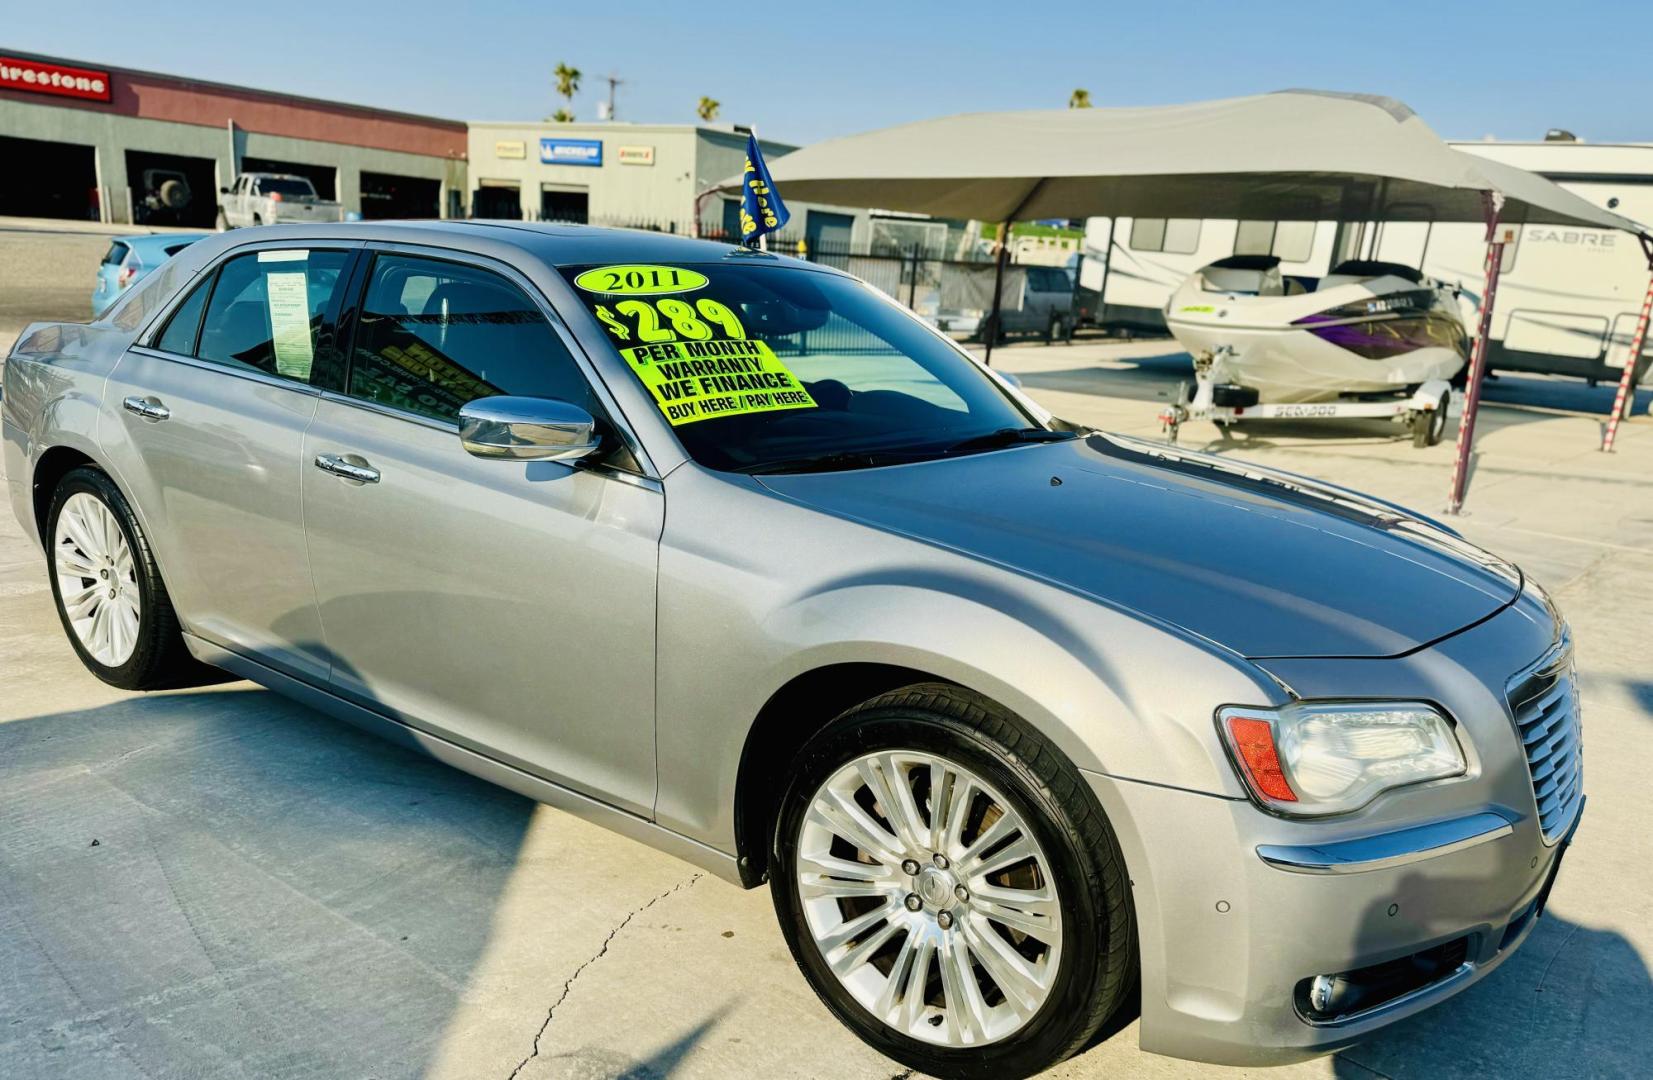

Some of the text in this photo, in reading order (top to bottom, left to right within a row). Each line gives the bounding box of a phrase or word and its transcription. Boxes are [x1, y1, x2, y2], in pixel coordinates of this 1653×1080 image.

[0, 62, 105, 93] irestone
[1527, 230, 1617, 247] SABRE
[603, 270, 682, 291] 2011
[594, 298, 747, 342] $289
[632, 341, 761, 365] PER MONTH
[656, 357, 763, 381] WARRANTY
[657, 372, 792, 401] WE FINANCE
[666, 402, 697, 420] BUY
[699, 396, 737, 414] HERE
[745, 393, 772, 407] PAY
[773, 391, 808, 405] HERE
